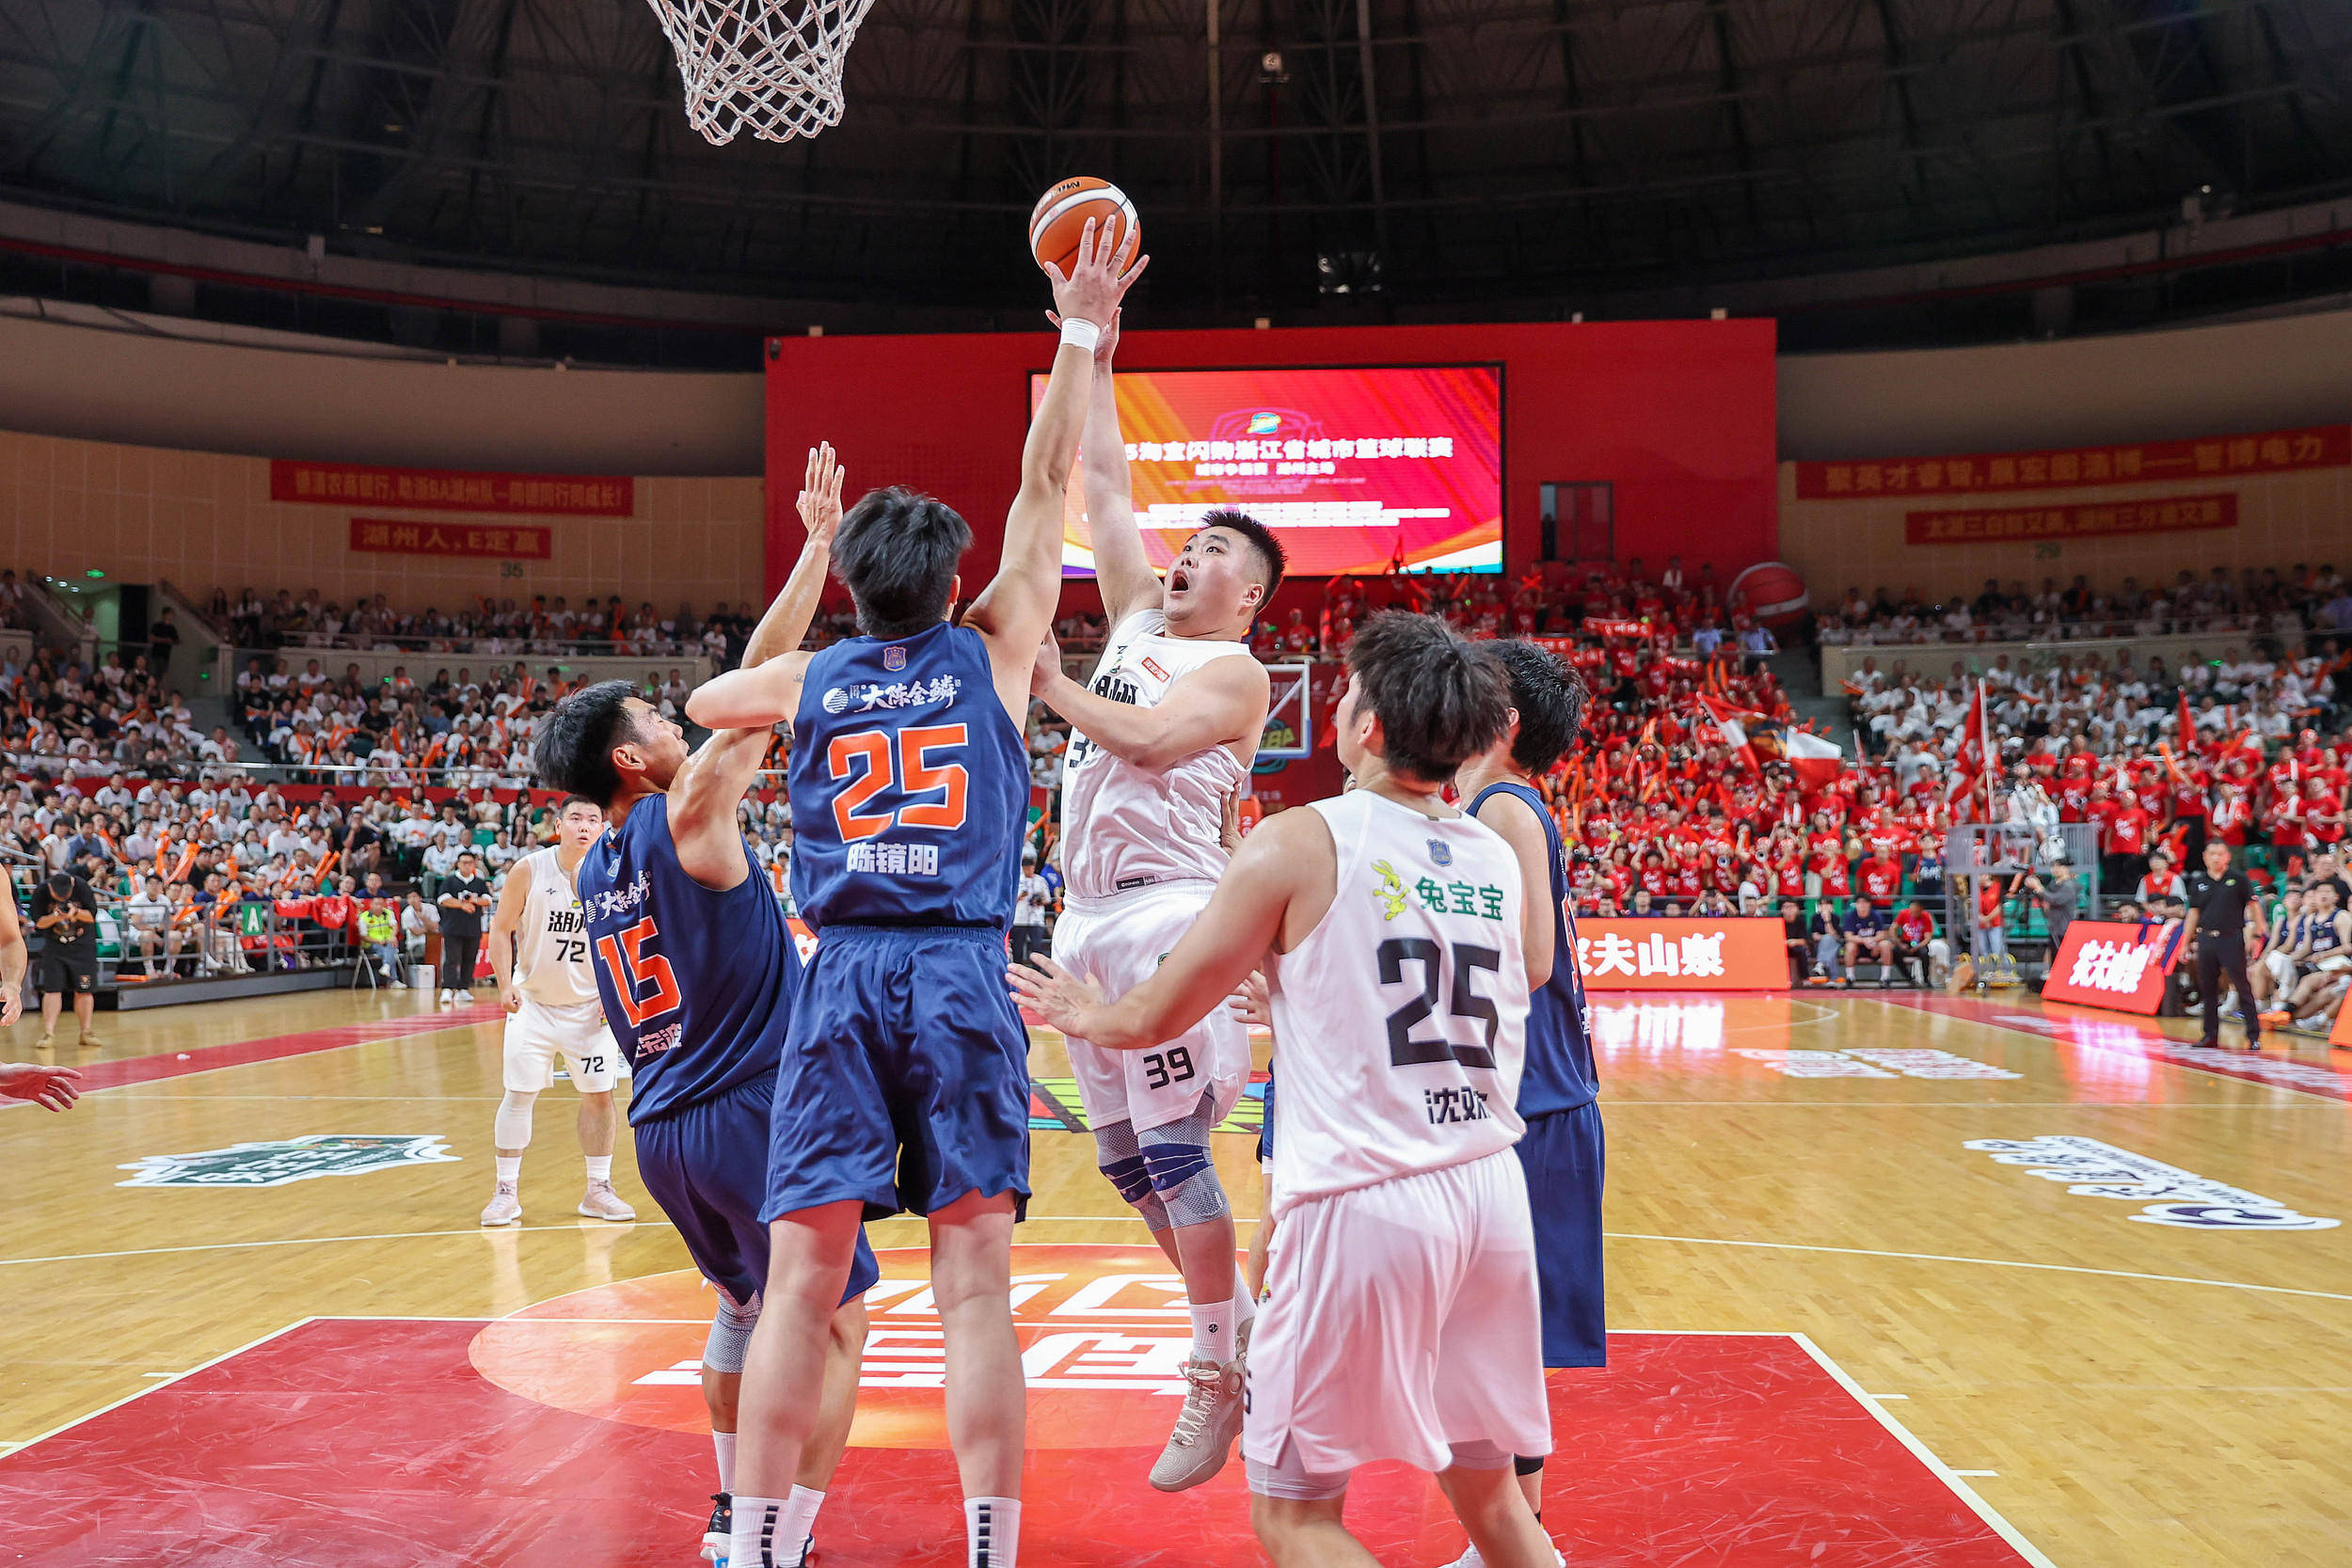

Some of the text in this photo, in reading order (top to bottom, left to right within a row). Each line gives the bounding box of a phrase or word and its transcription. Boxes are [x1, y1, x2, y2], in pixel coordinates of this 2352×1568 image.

[827, 721, 969, 844] 25
[247, 907, 261, 932] A
[1416, 876, 1504, 921] 兔宝宝
[555, 938, 586, 963] 72
[596, 914, 683, 1029] 15
[1376, 937, 1501, 1070] 25
[580, 1055, 605, 1074] 72
[1143, 1046, 1195, 1089] 39
